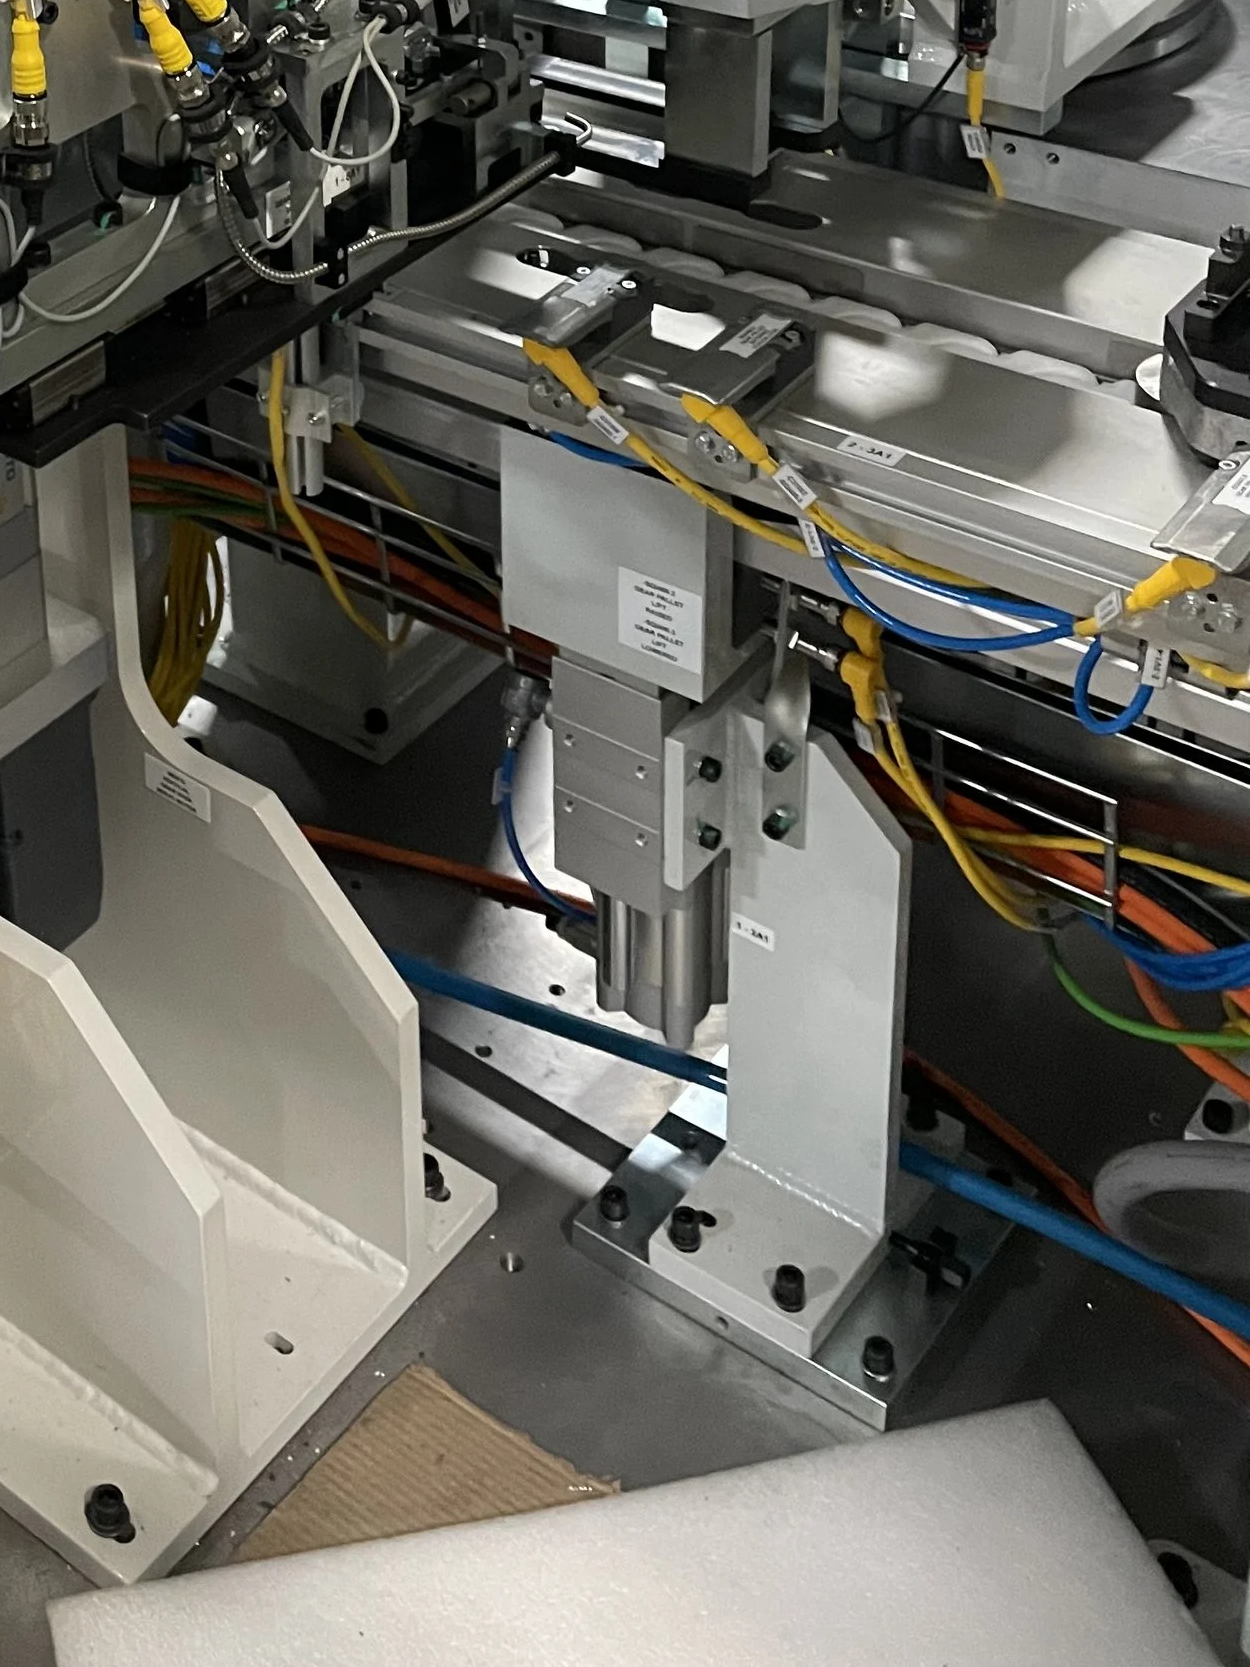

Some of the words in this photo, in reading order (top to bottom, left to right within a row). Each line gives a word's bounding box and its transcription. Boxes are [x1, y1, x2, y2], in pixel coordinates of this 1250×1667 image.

[651, 600, 667, 610] LIFT
[656, 593, 684, 609] PALLET
[651, 639, 667, 649] LIFT
[656, 632, 684, 647] PALLET
